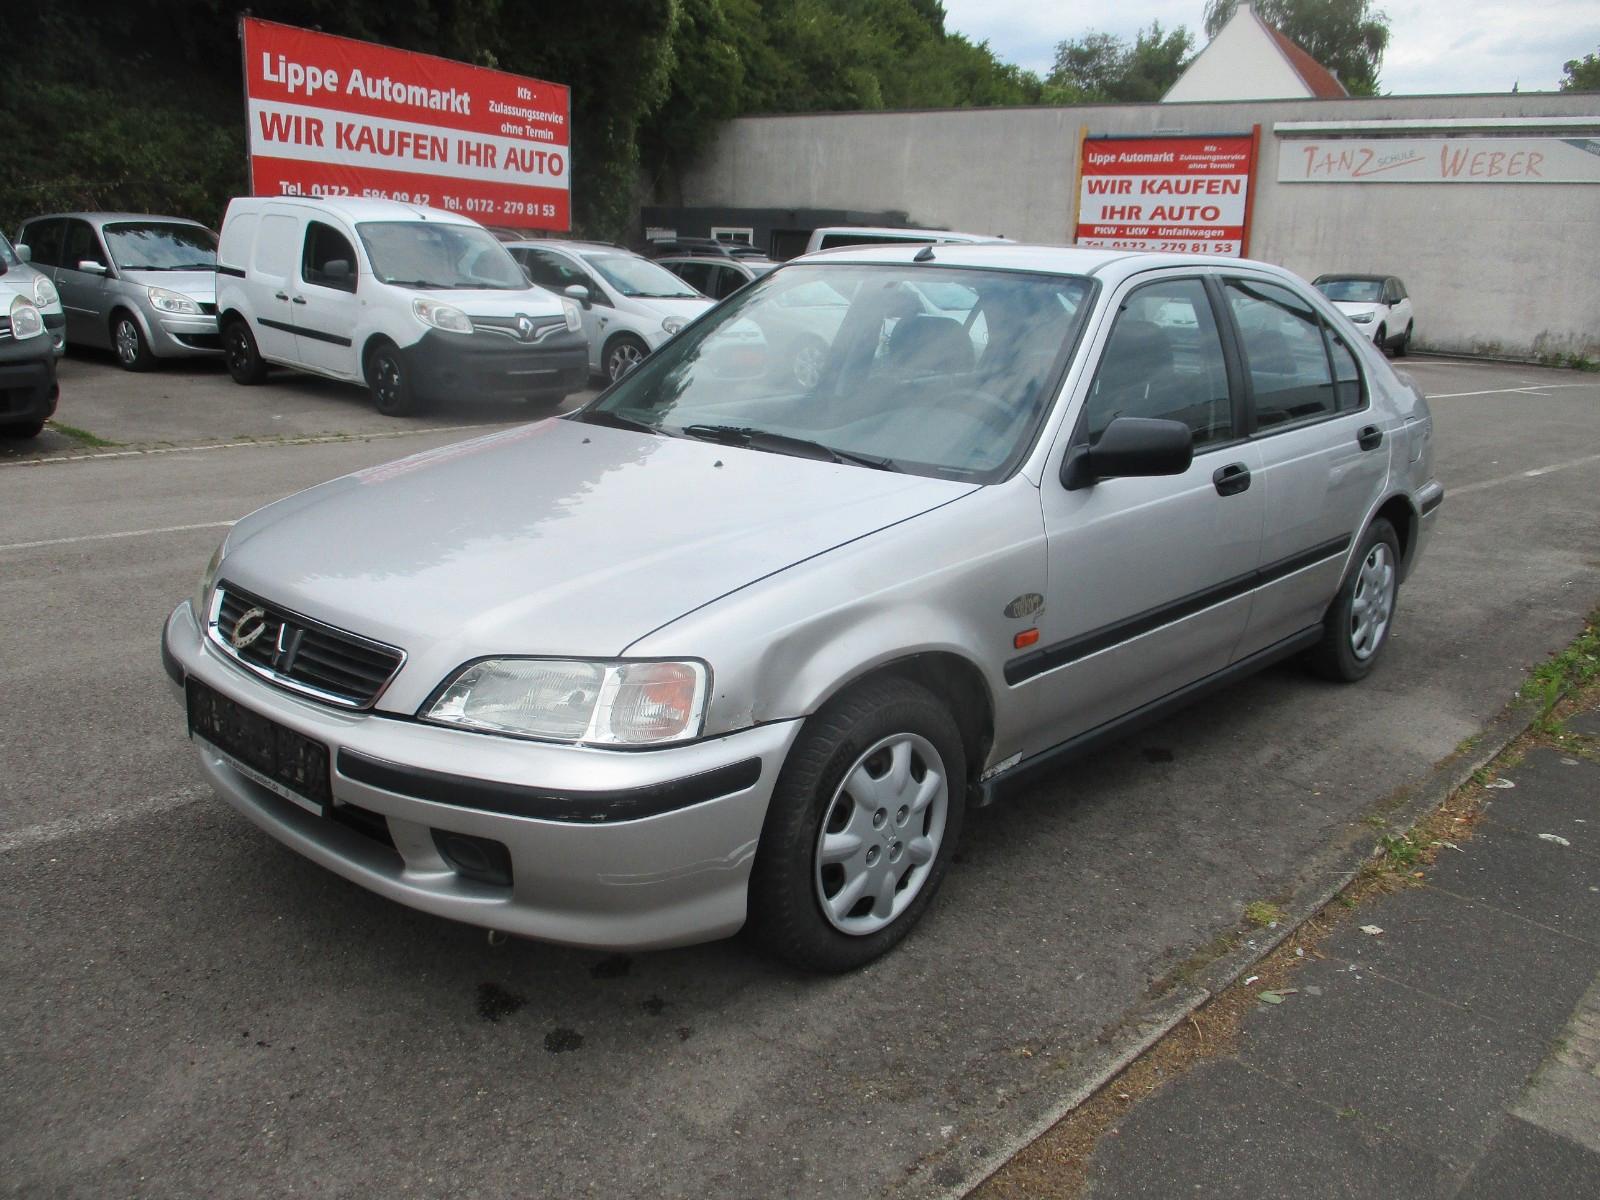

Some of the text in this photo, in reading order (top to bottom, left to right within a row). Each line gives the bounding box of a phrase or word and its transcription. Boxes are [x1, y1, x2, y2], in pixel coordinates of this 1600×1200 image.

[262, 52, 471, 116] Lippe Automarkt
[517, 86, 532, 100] Kfz
[488, 100, 564, 125] Zulassungsservice
[500, 122, 554, 140] ohne Termin
[259, 110, 564, 177] WIR KAUFEN IHR AUTO
[1088, 152, 1174, 165] Lippe Automarkt
[1179, 153, 1246, 162] Zulassungsservice
[1303, 144, 1545, 178] TANZ SCHULE WEBER
[279, 181, 306, 196] Tel.
[311, 183, 349, 197] 0172
[393, 191, 409, 202] 09
[413, 193, 430, 206] 42
[1087, 178, 1241, 195] WIR KAUFEN
[443, 195, 463, 210] Tel.
[466, 198, 494, 213] 0172
[504, 202, 524, 215] 279
[526, 204, 539, 216] 81
[542, 204, 556, 217] 53
[1101, 205, 1221, 222] IHR AUTO
[1094, 226, 1117, 235] PKW
[1126, 227, 1149, 236] LKW
[1158, 228, 1225, 238] Unfallwagen
[1160, 242, 1187, 252] 279
[1191, 243, 1208, 253] 81
[1214, 243, 1233, 253] 53
